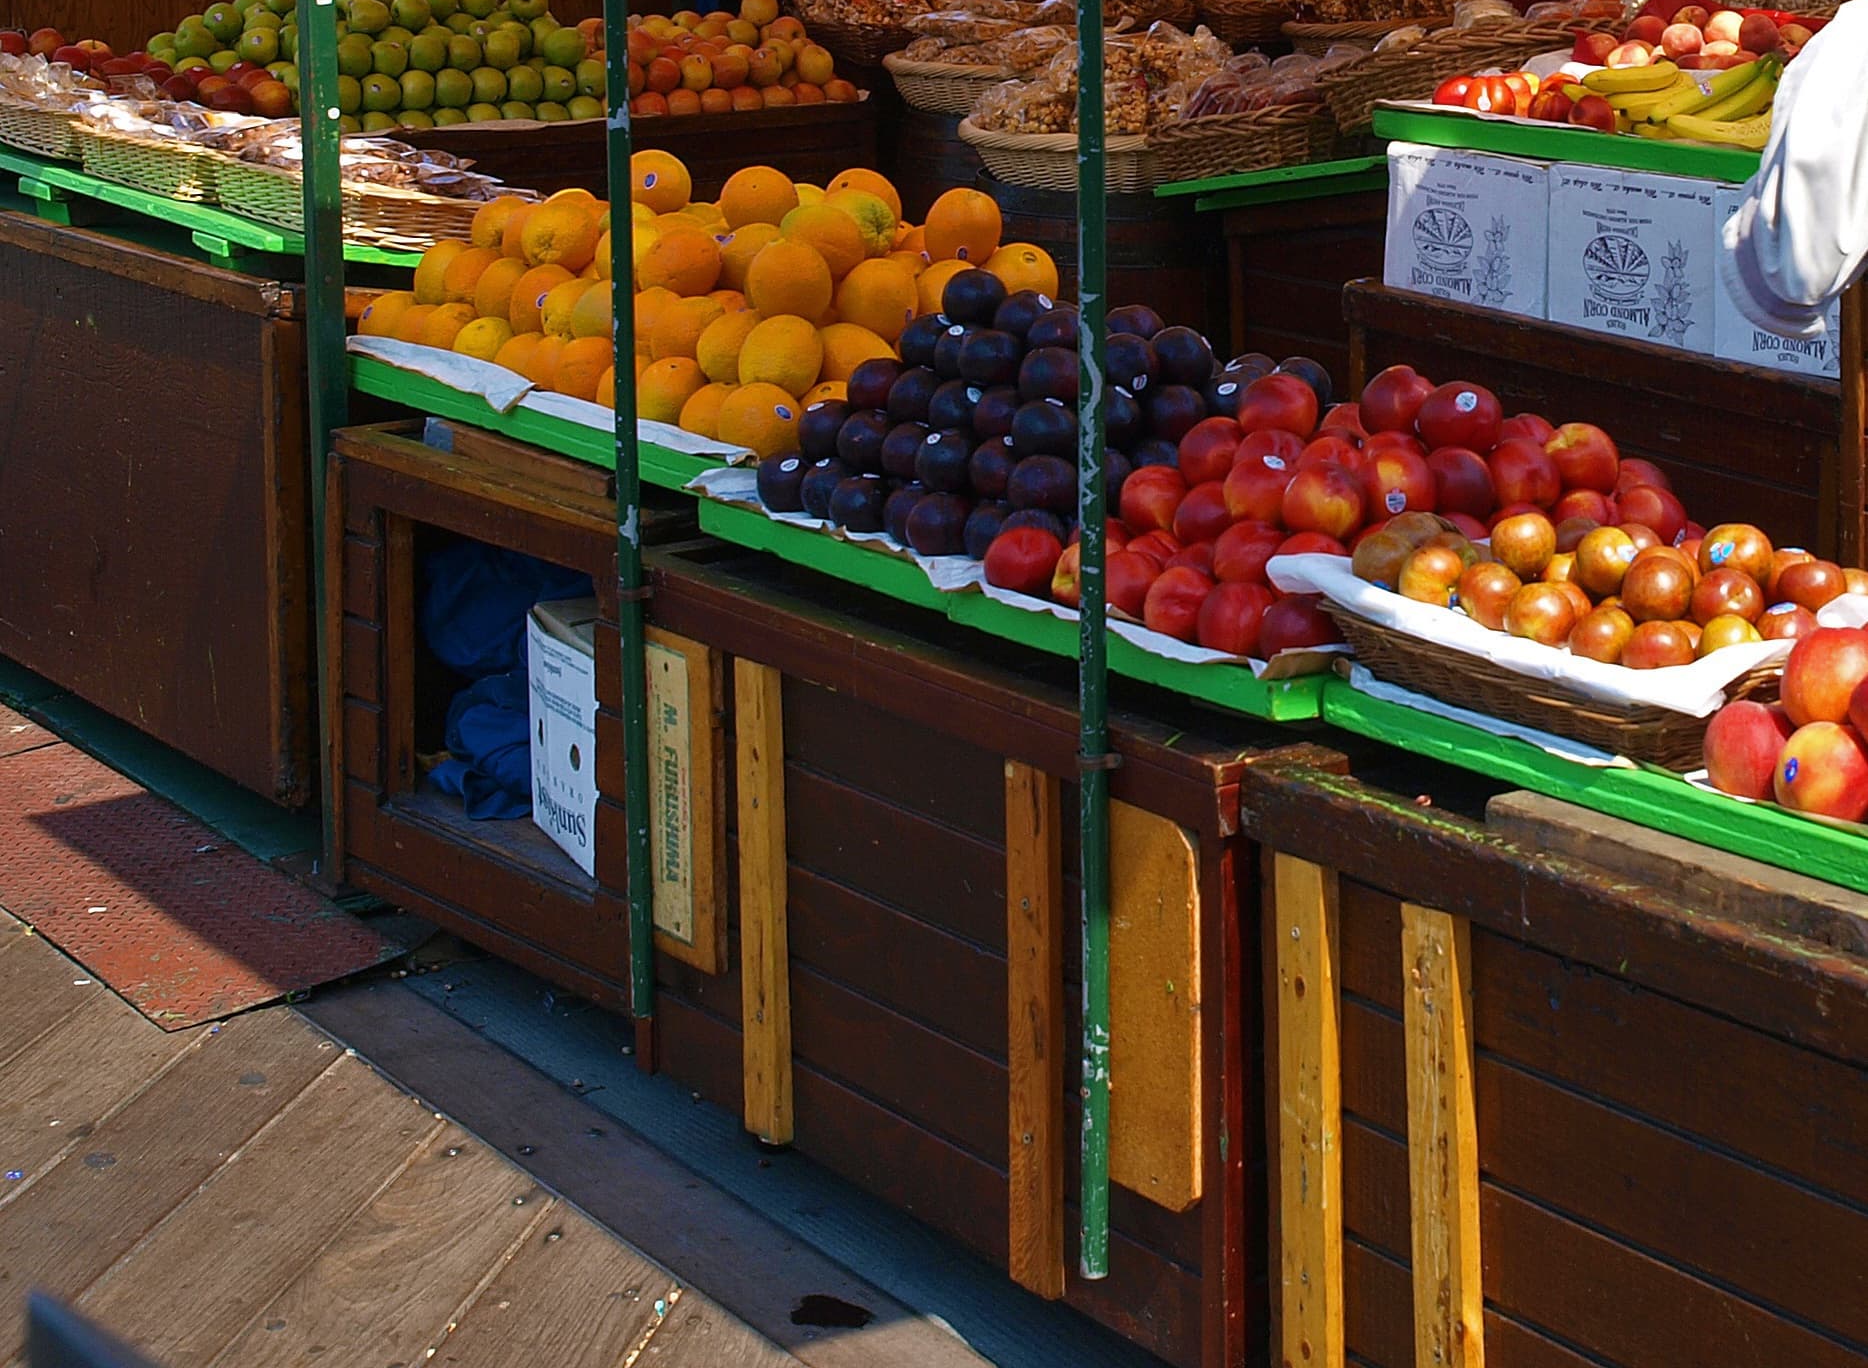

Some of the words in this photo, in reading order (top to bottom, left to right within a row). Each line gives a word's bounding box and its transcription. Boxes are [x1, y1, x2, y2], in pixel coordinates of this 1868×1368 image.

[1698, 195, 1712, 206] We
[1411, 267, 1434, 287] CORN
[1435, 276, 1472, 297] ALMOND
[1583, 298, 1609, 318] CORN
[1610, 306, 1651, 327] ALMOND
[1752, 330, 1780, 352] CORN
[1782, 339, 1827, 361] ALMOND
[663, 702, 678, 733] M.
[536, 777, 587, 848] Sunkist
[664, 745, 680, 882] FUKUSHIMA
